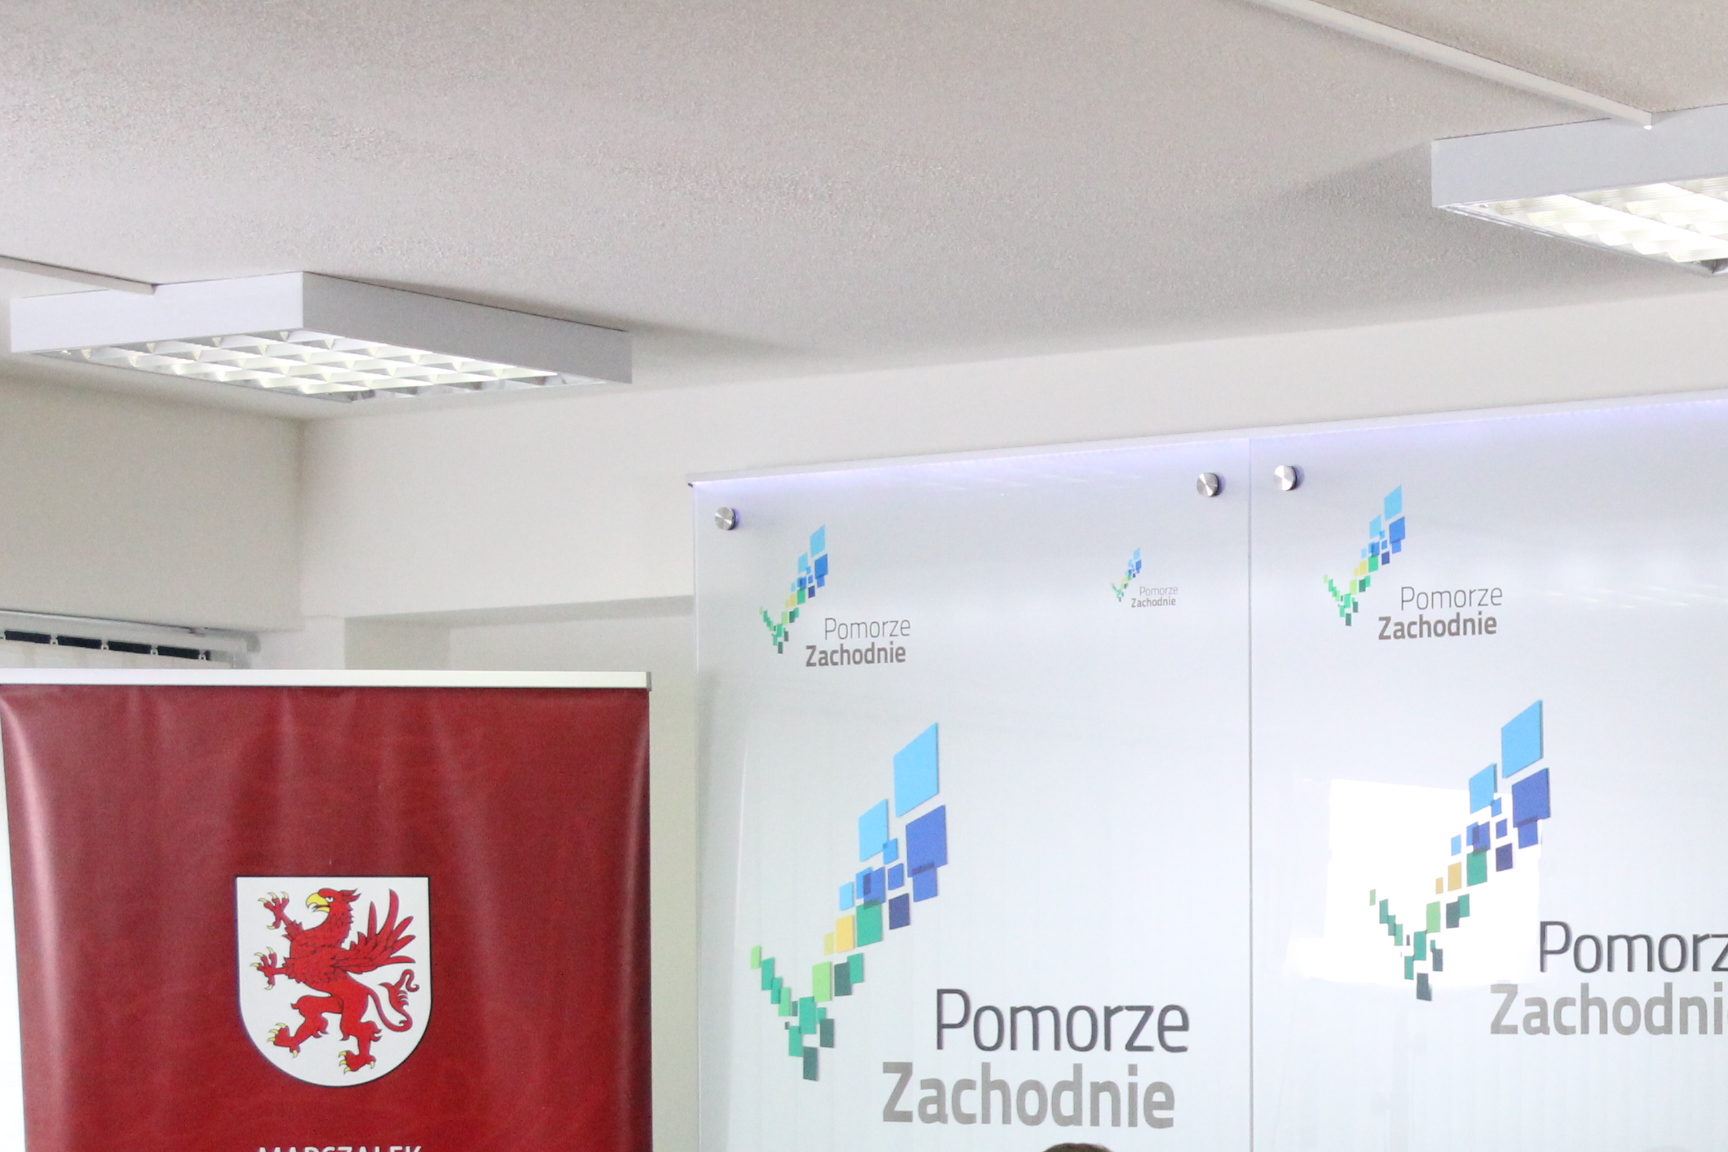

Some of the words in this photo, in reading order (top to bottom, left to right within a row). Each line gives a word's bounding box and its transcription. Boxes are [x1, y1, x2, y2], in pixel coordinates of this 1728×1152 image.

[1131, 596, 1177, 608] Zachodnie
[1139, 585, 1179, 597] Pomorze
[1400, 584, 1503, 611] Pomorze
[824, 617, 911, 638] Pomorze
[1377, 612, 1497, 640] Zachodnie
[806, 642, 907, 667] Zachodnie
[935, 988, 1190, 1053] Pomorze
[882, 1061, 1175, 1129] Zachodnie
